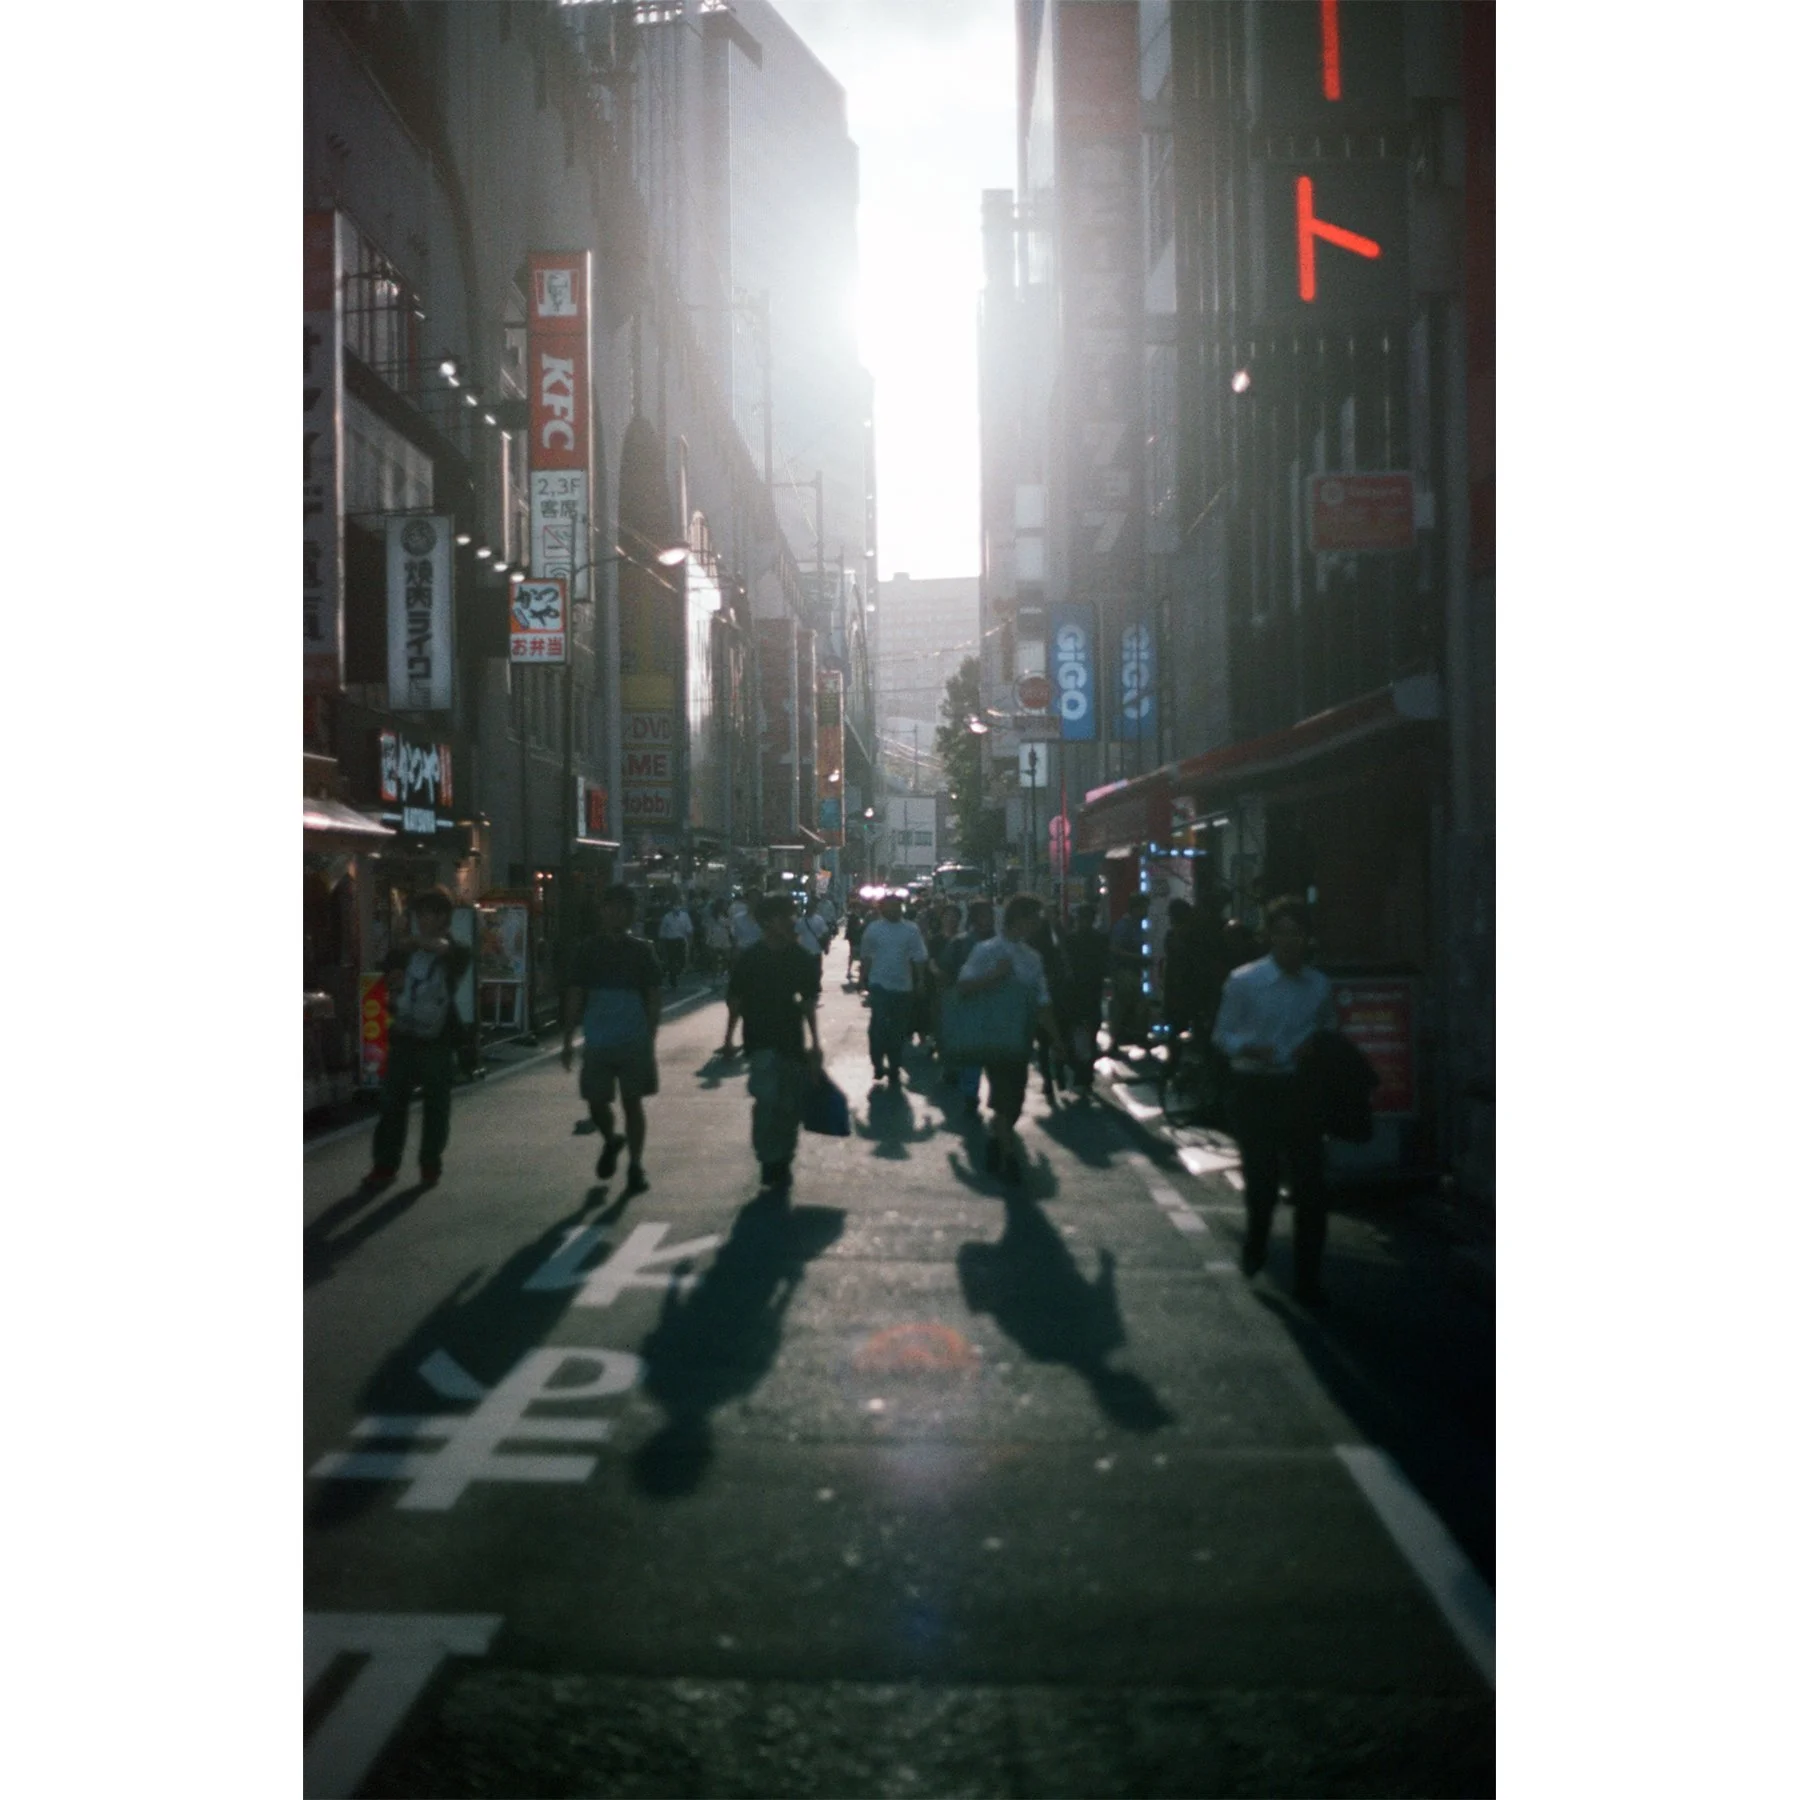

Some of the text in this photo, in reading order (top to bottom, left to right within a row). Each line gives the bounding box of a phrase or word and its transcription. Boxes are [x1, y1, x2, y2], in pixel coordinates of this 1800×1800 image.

[541, 352, 574, 451] KFC
[537, 478, 582, 497] 2,3F
[540, 500, 577, 520] 客席
[511, 637, 564, 657] お弁当
[621, 753, 667, 777] ME
